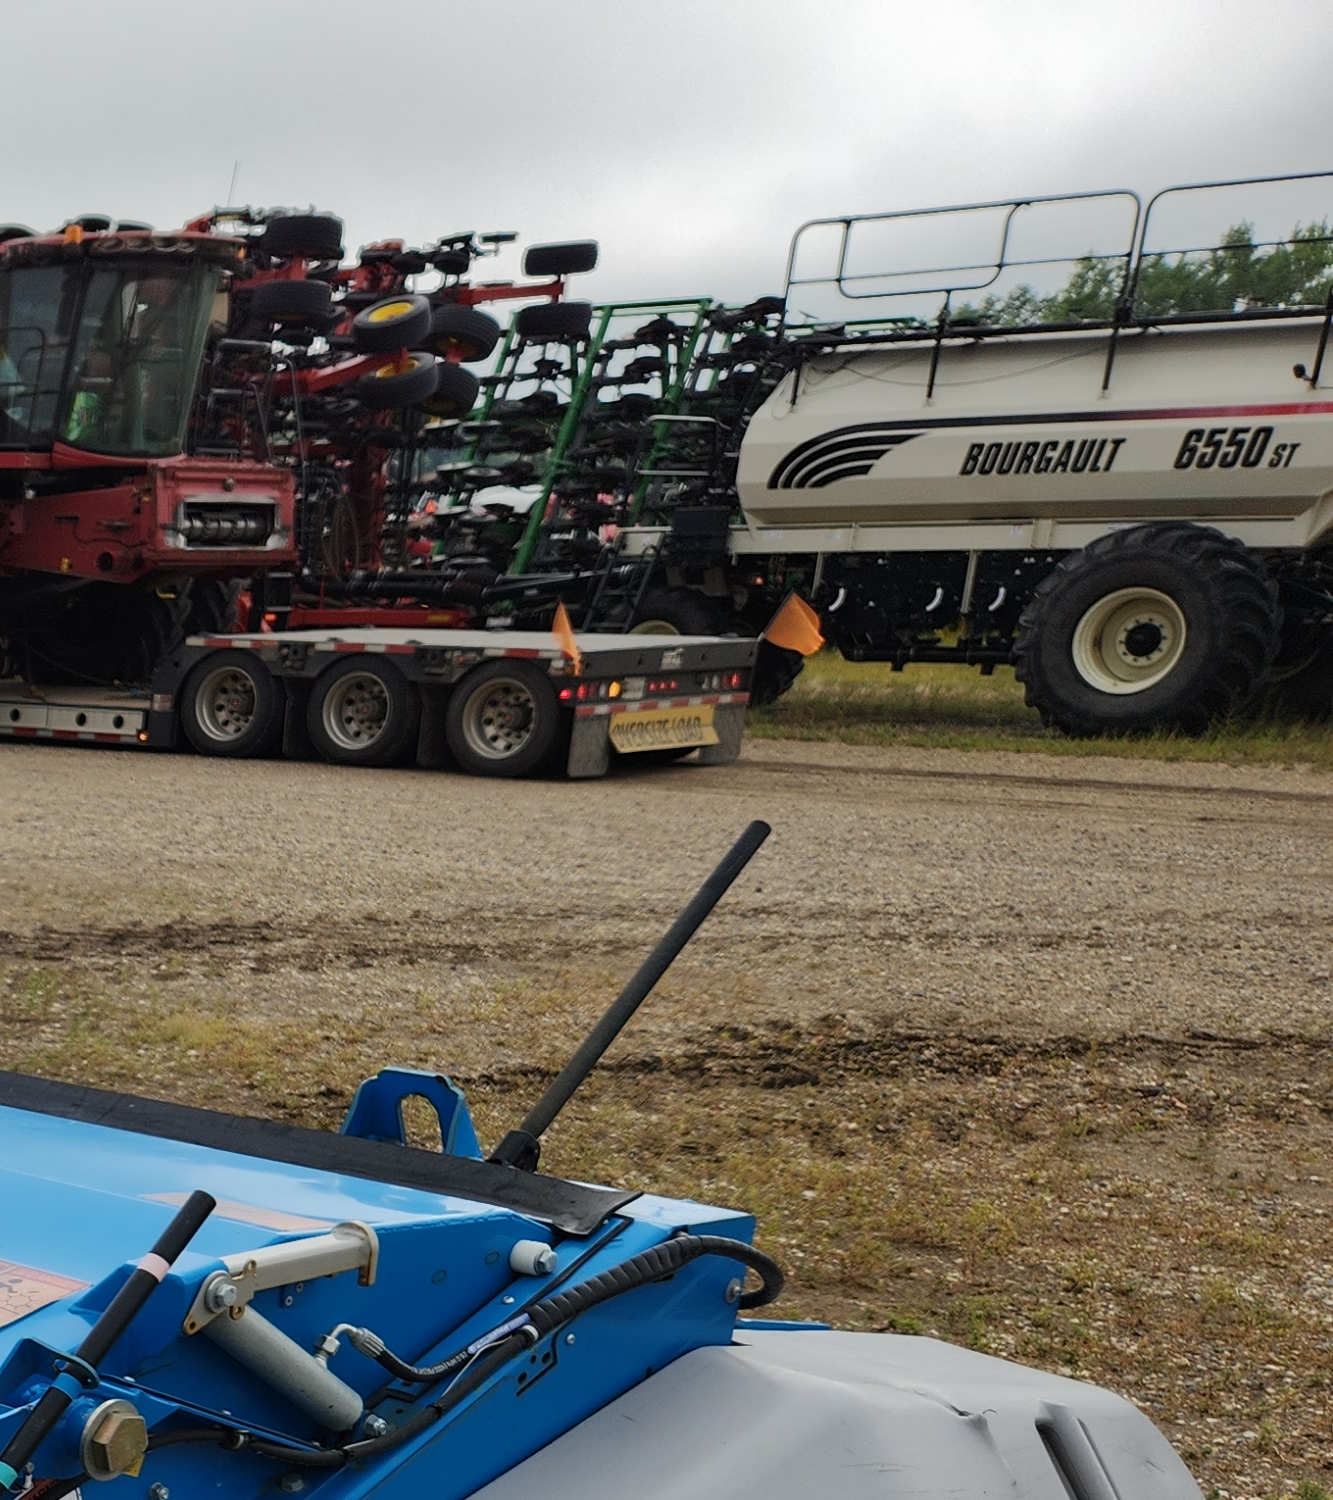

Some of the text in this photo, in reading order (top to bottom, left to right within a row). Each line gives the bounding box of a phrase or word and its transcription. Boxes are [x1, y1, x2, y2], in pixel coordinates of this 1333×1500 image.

[959, 426, 1301, 476] BOURGAULT 6550 ST
[611, 715, 703, 749] OVERSIZE LOAD
